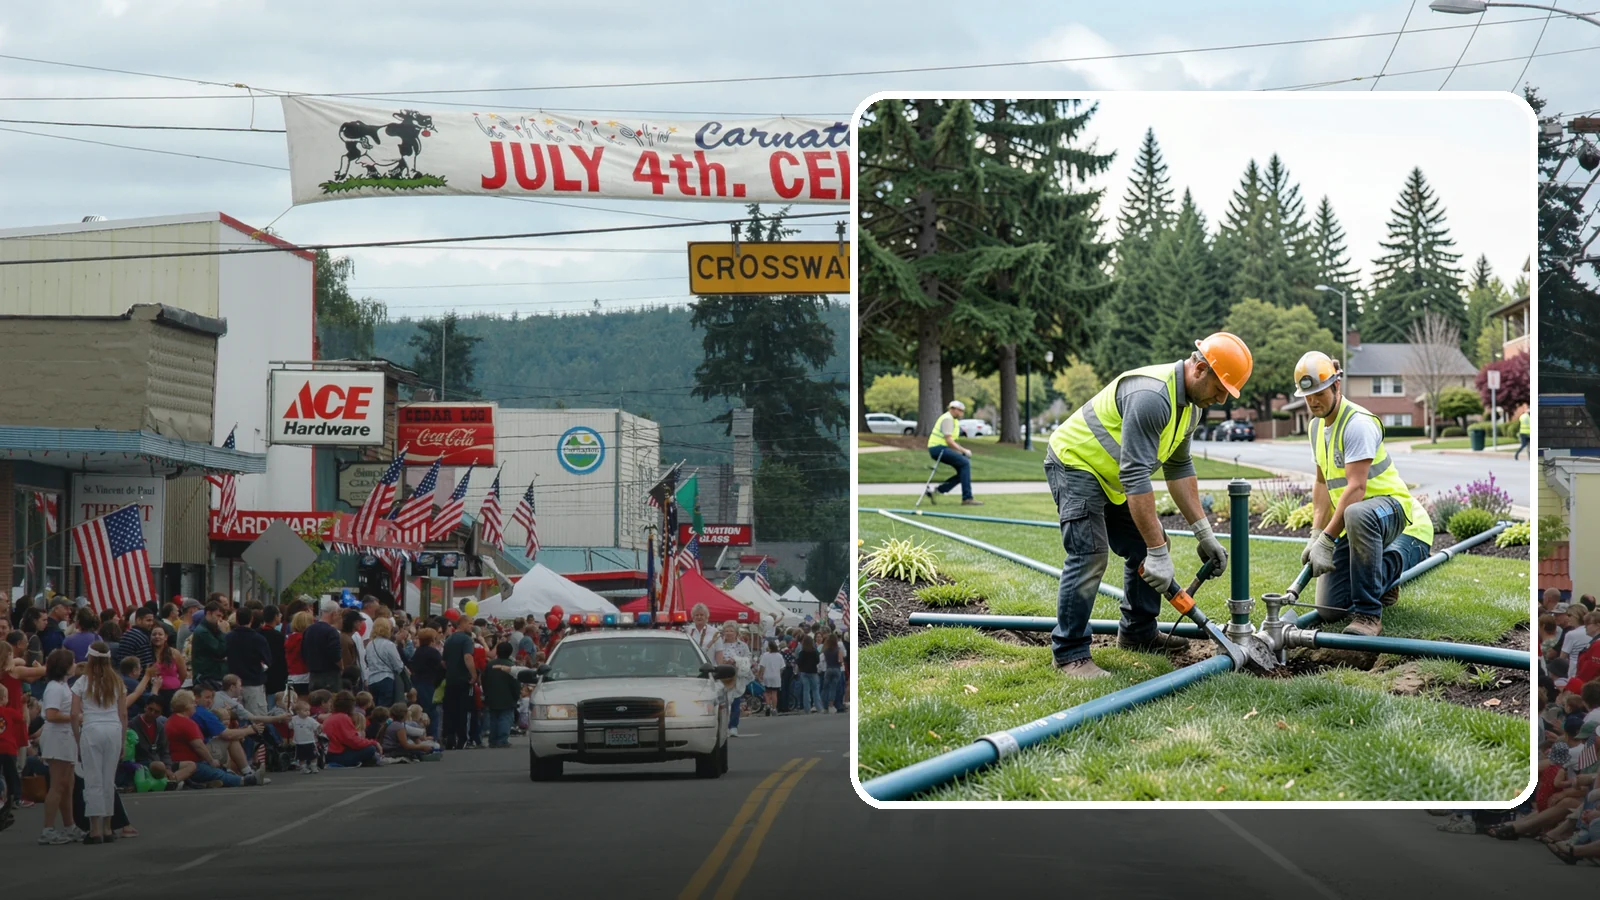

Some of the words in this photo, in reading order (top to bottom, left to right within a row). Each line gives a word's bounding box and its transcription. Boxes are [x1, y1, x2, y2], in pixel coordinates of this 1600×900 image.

[481, 141, 605, 193] JULY
[632, 149, 746, 197] 4th.
[697, 254, 850, 280] CROSSWA
[283, 380, 373, 420] ACE
[406, 409, 453, 422] CEDAR
[461, 409, 485, 422] LOG
[283, 421, 371, 437] Hardware
[416, 427, 477, 447] Coca-Cola
[83, 485, 93, 494] St.
[96, 485, 124, 495] Vincent
[126, 486, 135, 495] de
[137, 486, 155, 495] Paul
[688, 526, 741, 535] CRNATION
[699, 535, 730, 544] GLASS
